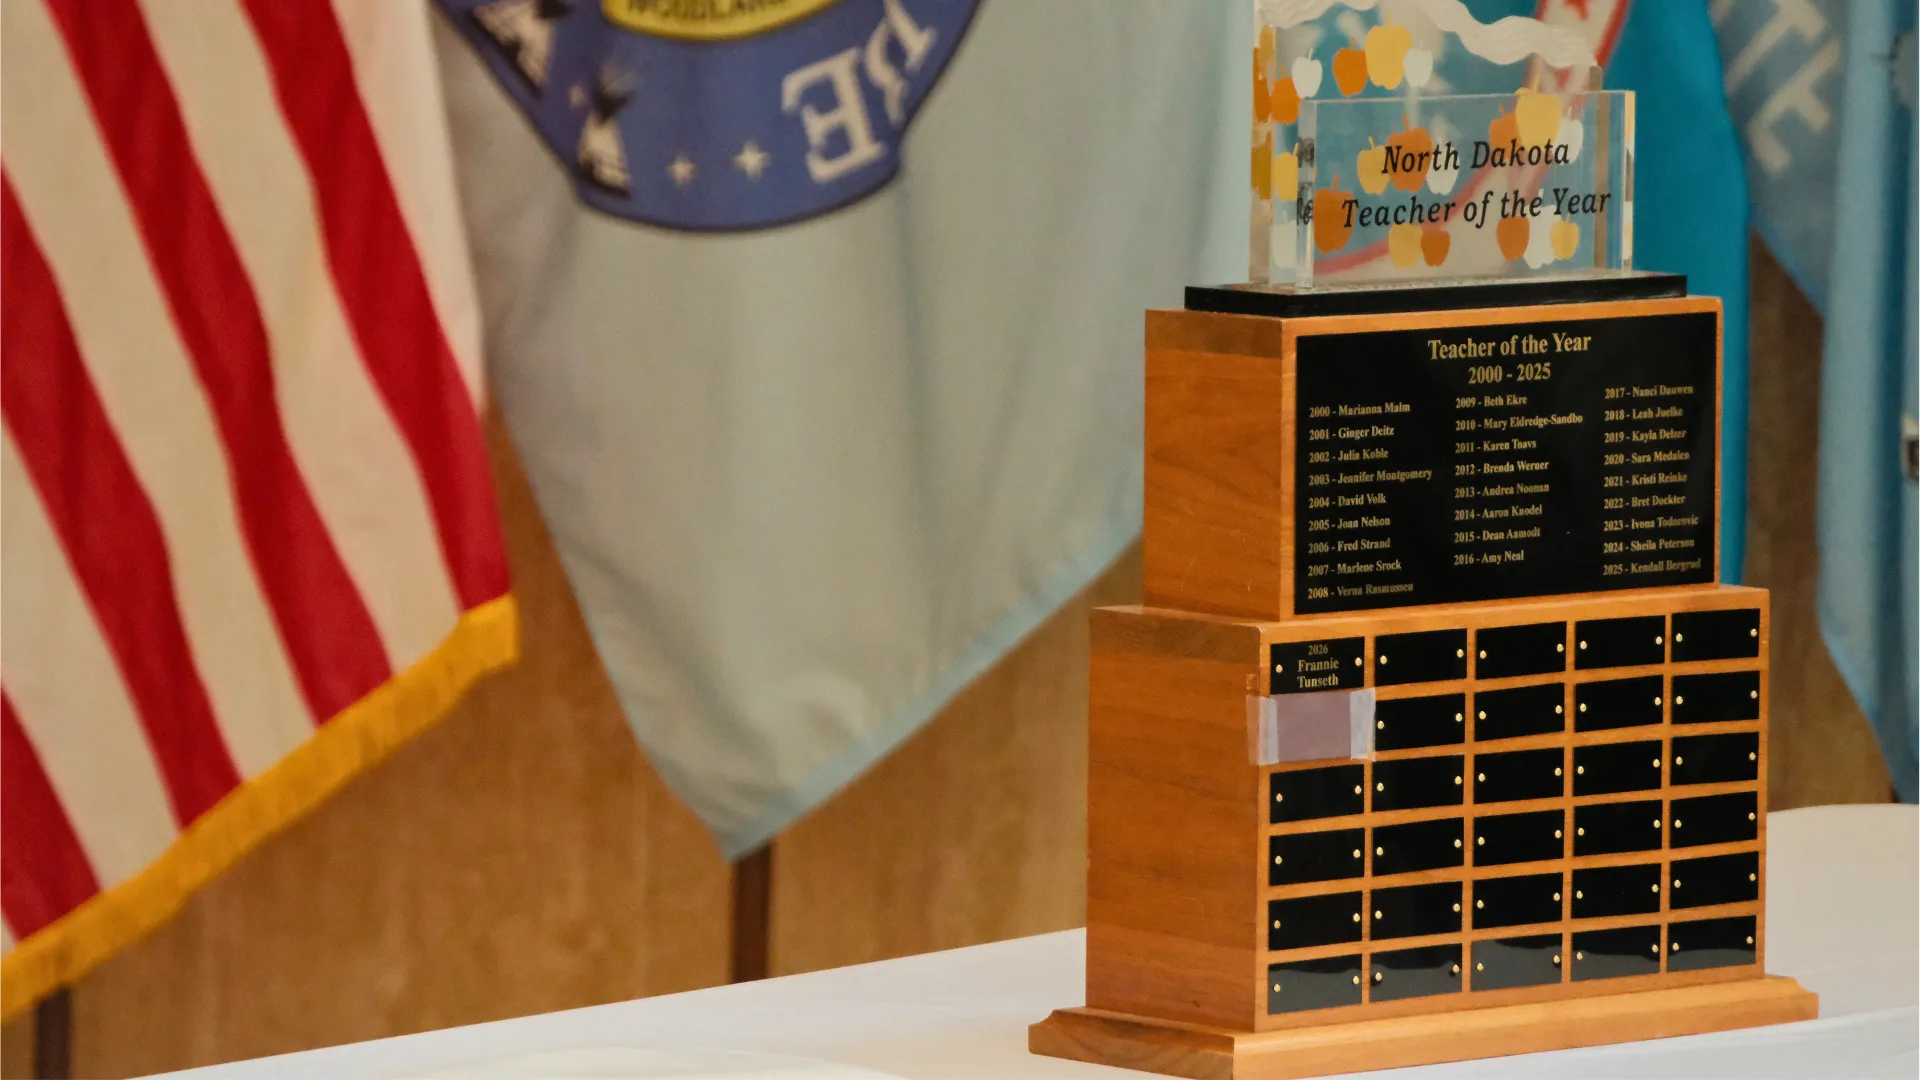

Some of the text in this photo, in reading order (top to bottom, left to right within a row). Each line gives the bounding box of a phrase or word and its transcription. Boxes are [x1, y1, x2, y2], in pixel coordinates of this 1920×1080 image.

[1381, 138, 1570, 174] North Dakota
[1341, 187, 1612, 229] Teacher of the Year
[1427, 332, 1592, 360] Teacher of the Year
[1468, 365, 1503, 384] 2000
[1516, 362, 1552, 382] 2025
[1604, 387, 1625, 399] 2017
[1632, 385, 1657, 398] Nanci
[1309, 406, 1331, 418] 2000
[1338, 404, 1383, 417] Marianna
[1384, 401, 1411, 413] Malm
[1455, 396, 1476, 409] 2009
[1484, 395, 1504, 407] Beth
[1506, 394, 1528, 406] Ekre
[1455, 419, 1476, 431] 2010
[1483, 418, 1507, 431] Mary
[1509, 412, 1583, 429] Eldredge-Sandbo
[1604, 409, 1625, 422] 2018
[1632, 407, 1654, 420] Leah
[1309, 428, 1330, 441] 2001
[1338, 427, 1370, 440] Ginger
[1371, 424, 1395, 437] Deitz
[1604, 431, 1625, 444] 2019
[1632, 429, 1657, 444] Kayla
[1455, 441, 1475, 454] 2011
[1483, 440, 1510, 452] Karen
[1511, 438, 1537, 450] Toavs
[1309, 451, 1330, 464] 2002
[1337, 449, 1360, 462] Julia
[1362, 447, 1389, 460] Koble
[1603, 453, 1625, 466] 2020
[1631, 452, 1652, 464] Sara
[1653, 449, 1690, 462] Medalen
[1455, 463, 1475, 476] 2012
[1483, 461, 1515, 474] Brenda
[1516, 460, 1550, 471] Werner
[1308, 473, 1330, 486] 2003
[1337, 471, 1374, 484] Jennifer
[1376, 469, 1433, 483] Montgomery
[1603, 475, 1624, 488] 2021
[1631, 473, 1656, 486] Kristi
[1658, 471, 1688, 484] Reinke
[1454, 486, 1475, 499] 2013
[1482, 484, 1514, 497] Andrea
[1516, 483, 1550, 494] Noonan
[1308, 496, 1330, 509] 2004
[1337, 494, 1365, 507] David
[1366, 493, 1387, 504] Volk
[1603, 497, 1624, 510] 2022
[1631, 496, 1650, 508] Bret
[1652, 494, 1686, 506] Dockter
[1454, 508, 1475, 521] 2014
[1482, 508, 1509, 519] Aaron
[1511, 503, 1543, 517] Knodel
[1308, 518, 1330, 532] 2005
[1337, 518, 1359, 529] Joan
[1361, 516, 1391, 527] Nelson
[1603, 519, 1624, 532] 2023
[1631, 518, 1655, 530] Ivona
[1657, 514, 1699, 528] Todorovic
[1454, 531, 1475, 543] 2015
[1482, 529, 1505, 541] Dean
[1506, 526, 1540, 540] Aamodt
[1308, 541, 1329, 554] 2006
[1337, 540, 1359, 552] Fred
[1360, 537, 1391, 550] Strand
[1603, 541, 1624, 554] 2024
[1630, 539, 1657, 552] Sheila
[1659, 538, 1695, 549] Peterson
[1453, 553, 1474, 566] 2016
[1481, 552, 1502, 565] Amy
[1504, 549, 1524, 562] Neal
[1308, 564, 1329, 577] 2007
[1337, 562, 1374, 574] Marlene
[1375, 559, 1402, 571] Srock
[1602, 563, 1624, 576] 2025
[1631, 560, 1664, 574] Kendall
[1307, 587, 1329, 599] 2008
[1365, 583, 1414, 595] Rasmussen
[1308, 643, 1329, 656] 2026
[1297, 657, 1339, 673] Frannie
[1296, 673, 1339, 689] Tunseth
